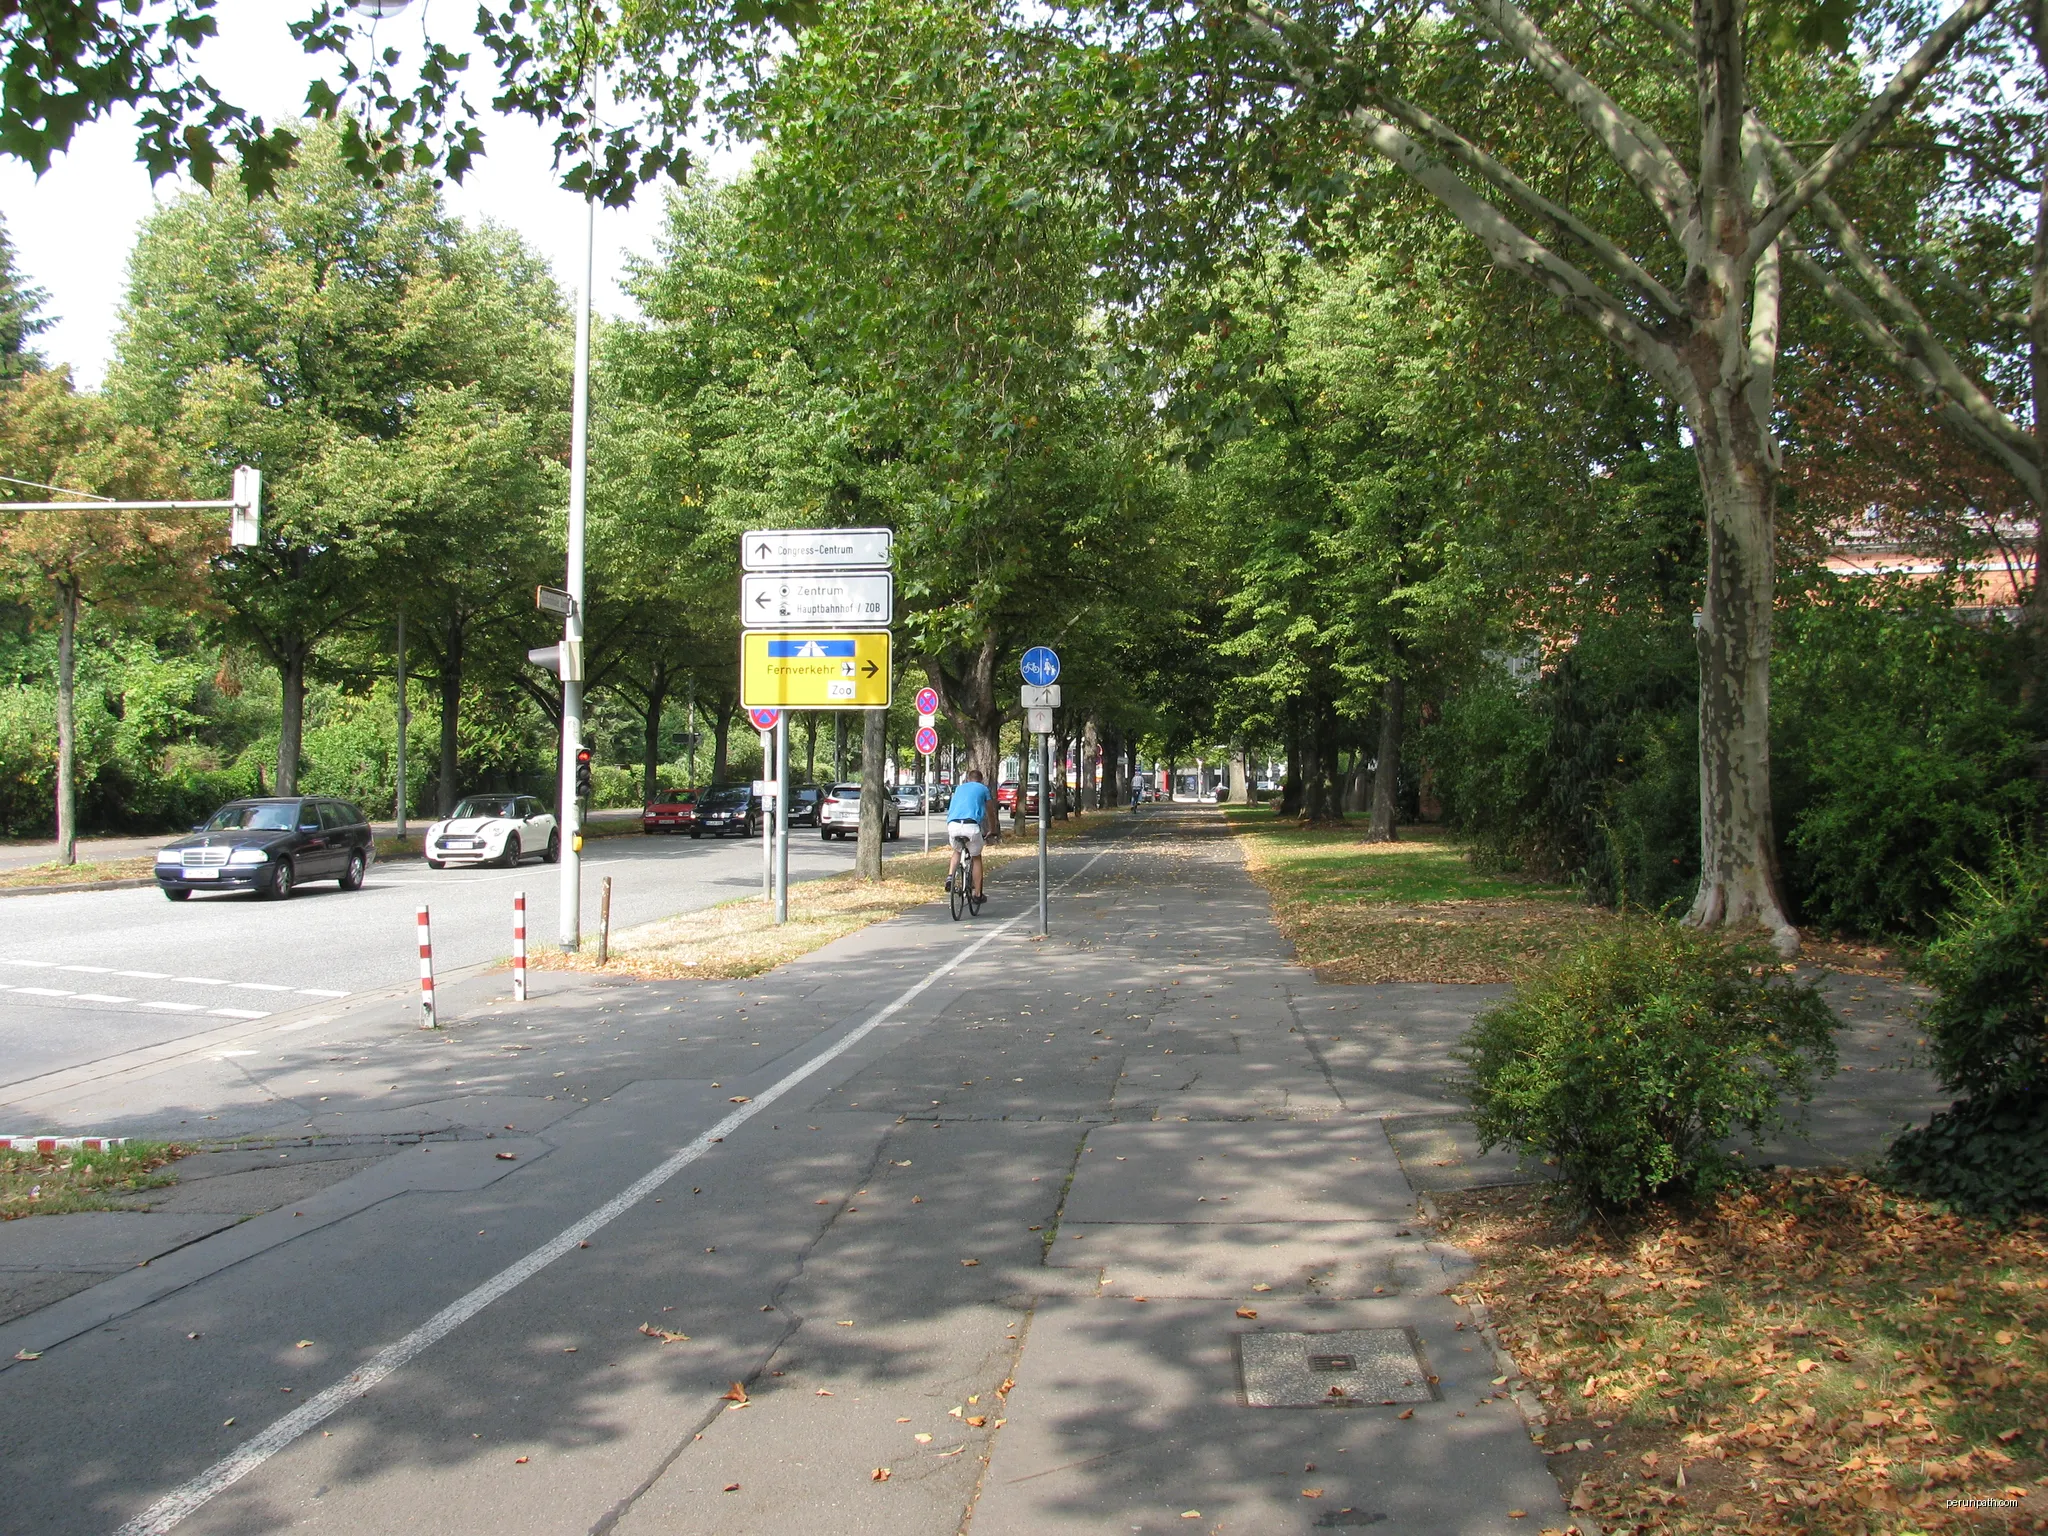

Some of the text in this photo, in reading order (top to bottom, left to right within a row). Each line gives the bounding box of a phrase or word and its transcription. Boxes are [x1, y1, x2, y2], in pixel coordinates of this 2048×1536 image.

[778, 545, 853, 557] Congress-Centrum
[797, 586, 843, 596] Zentrum
[797, 603, 853, 615] Hauptbahnhof
[865, 602, 880, 613] ZOB
[767, 664, 835, 675] Fernverkehr
[832, 685, 852, 695] Zoo
